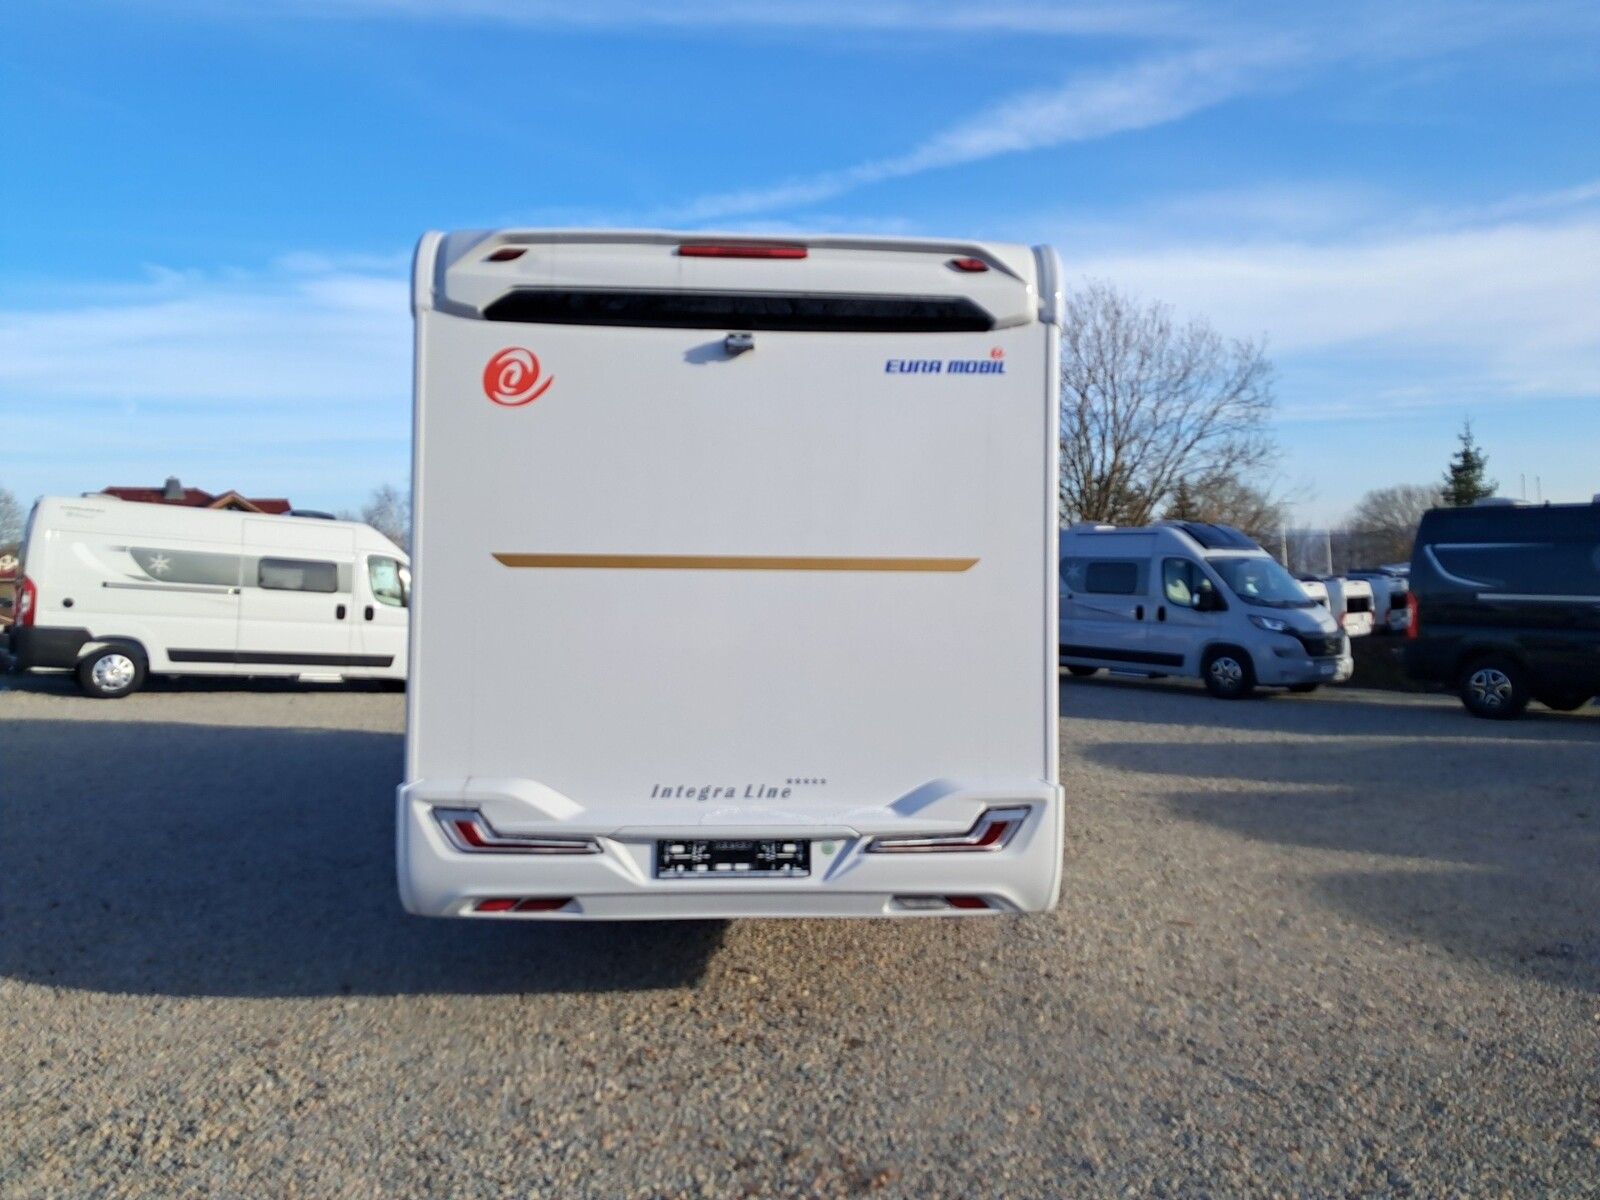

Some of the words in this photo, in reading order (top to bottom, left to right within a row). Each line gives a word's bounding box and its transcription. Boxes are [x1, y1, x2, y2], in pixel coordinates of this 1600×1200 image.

[947, 359, 1005, 374] MOBIL
[651, 783, 736, 801] Integra
[744, 783, 792, 799] Line
